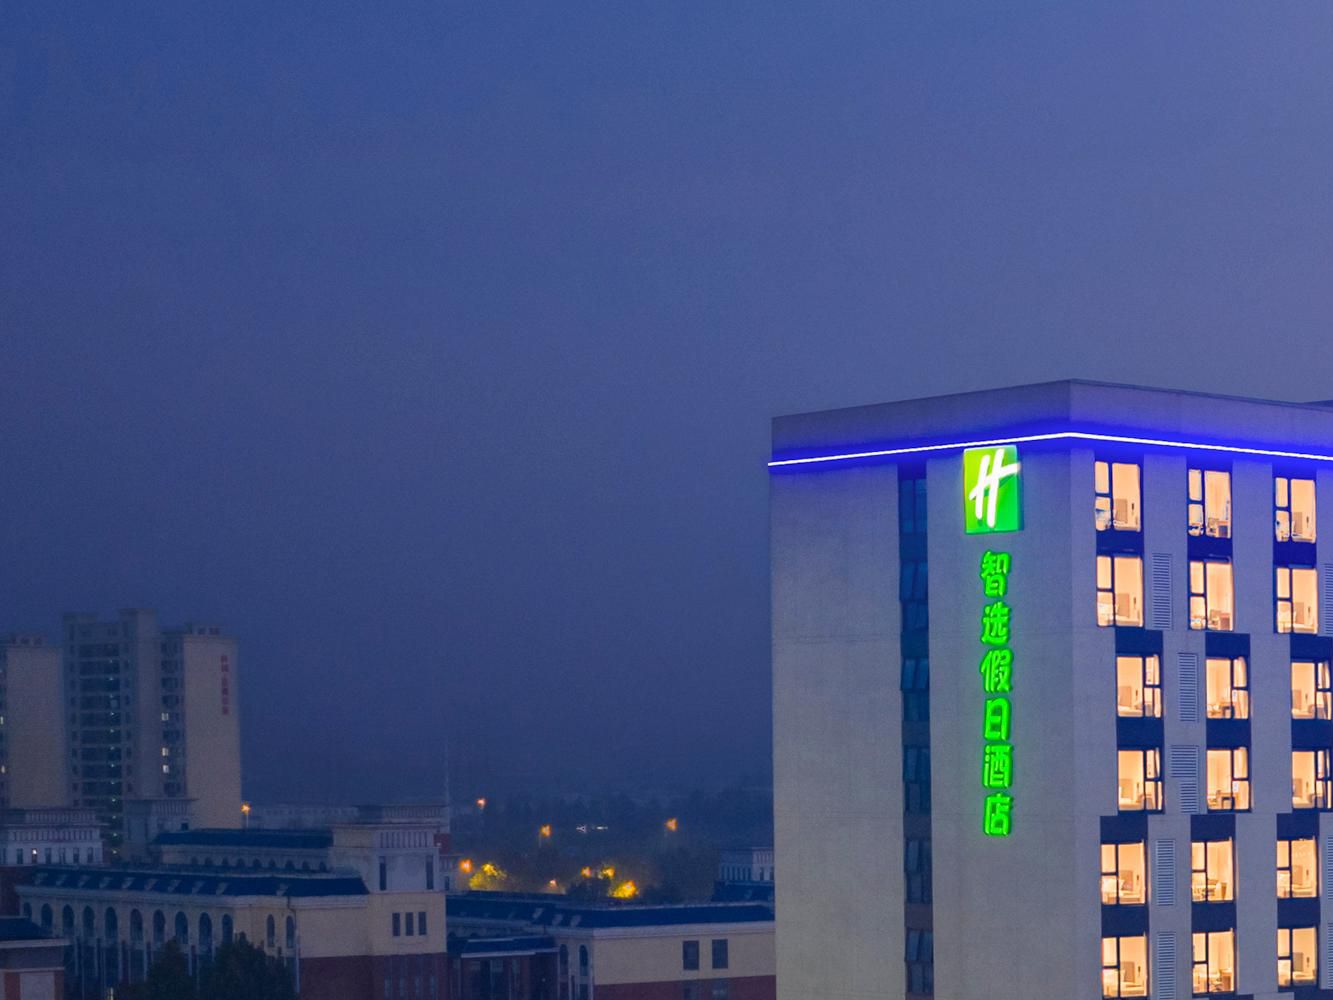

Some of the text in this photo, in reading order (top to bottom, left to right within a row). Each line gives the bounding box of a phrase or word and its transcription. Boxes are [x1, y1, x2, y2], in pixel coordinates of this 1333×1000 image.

[980, 549, 1014, 837] 智选假日酒店
